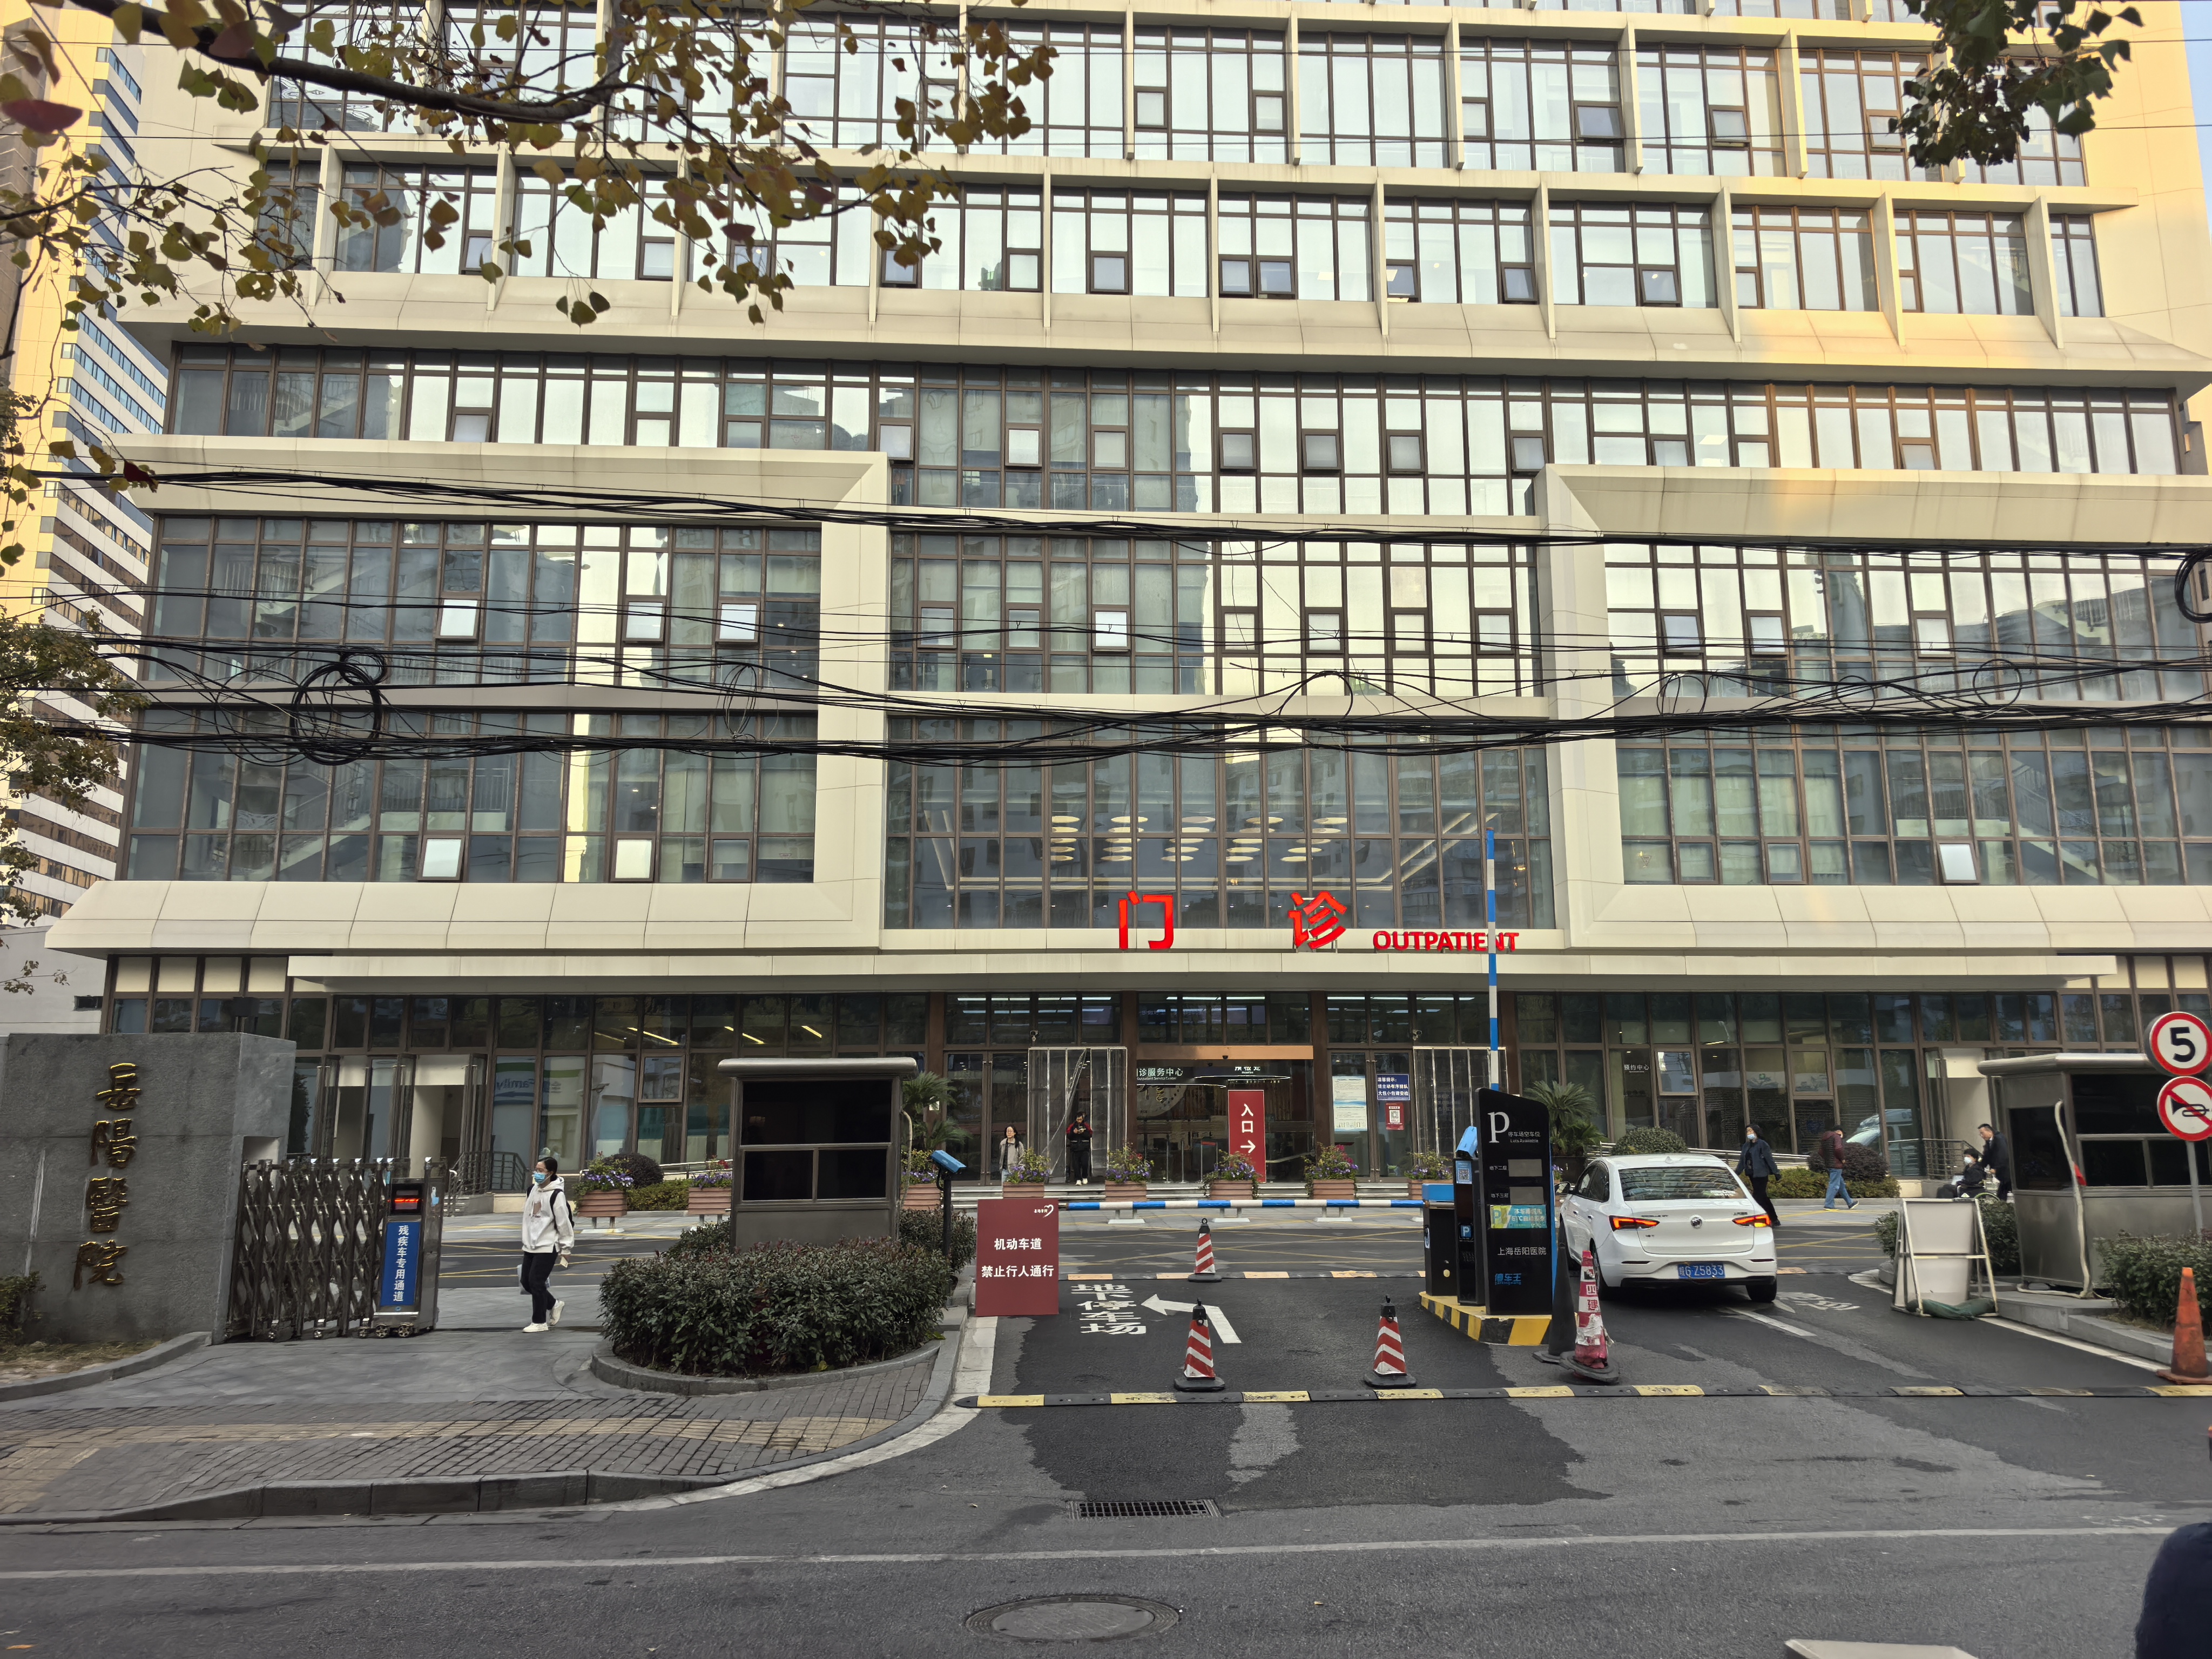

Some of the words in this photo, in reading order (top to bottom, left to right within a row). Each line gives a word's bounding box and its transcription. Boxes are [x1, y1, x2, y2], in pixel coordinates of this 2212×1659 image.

[1119, 891, 1346, 949] 门诊
[1373, 930, 1519, 952] OUTPATIENT
[2169, 1027, 2195, 1063] 5
[1241, 1103, 1253, 1133] 入口
[1487, 1111, 1510, 1143] P
[994, 1238, 1042, 1250] 机动车道
[1498, 1247, 1547, 1256] 上海岳阳医院
[393, 1225, 409, 1301] 残疾车专用通道
[981, 1265, 1054, 1278] 禁止行人通行
